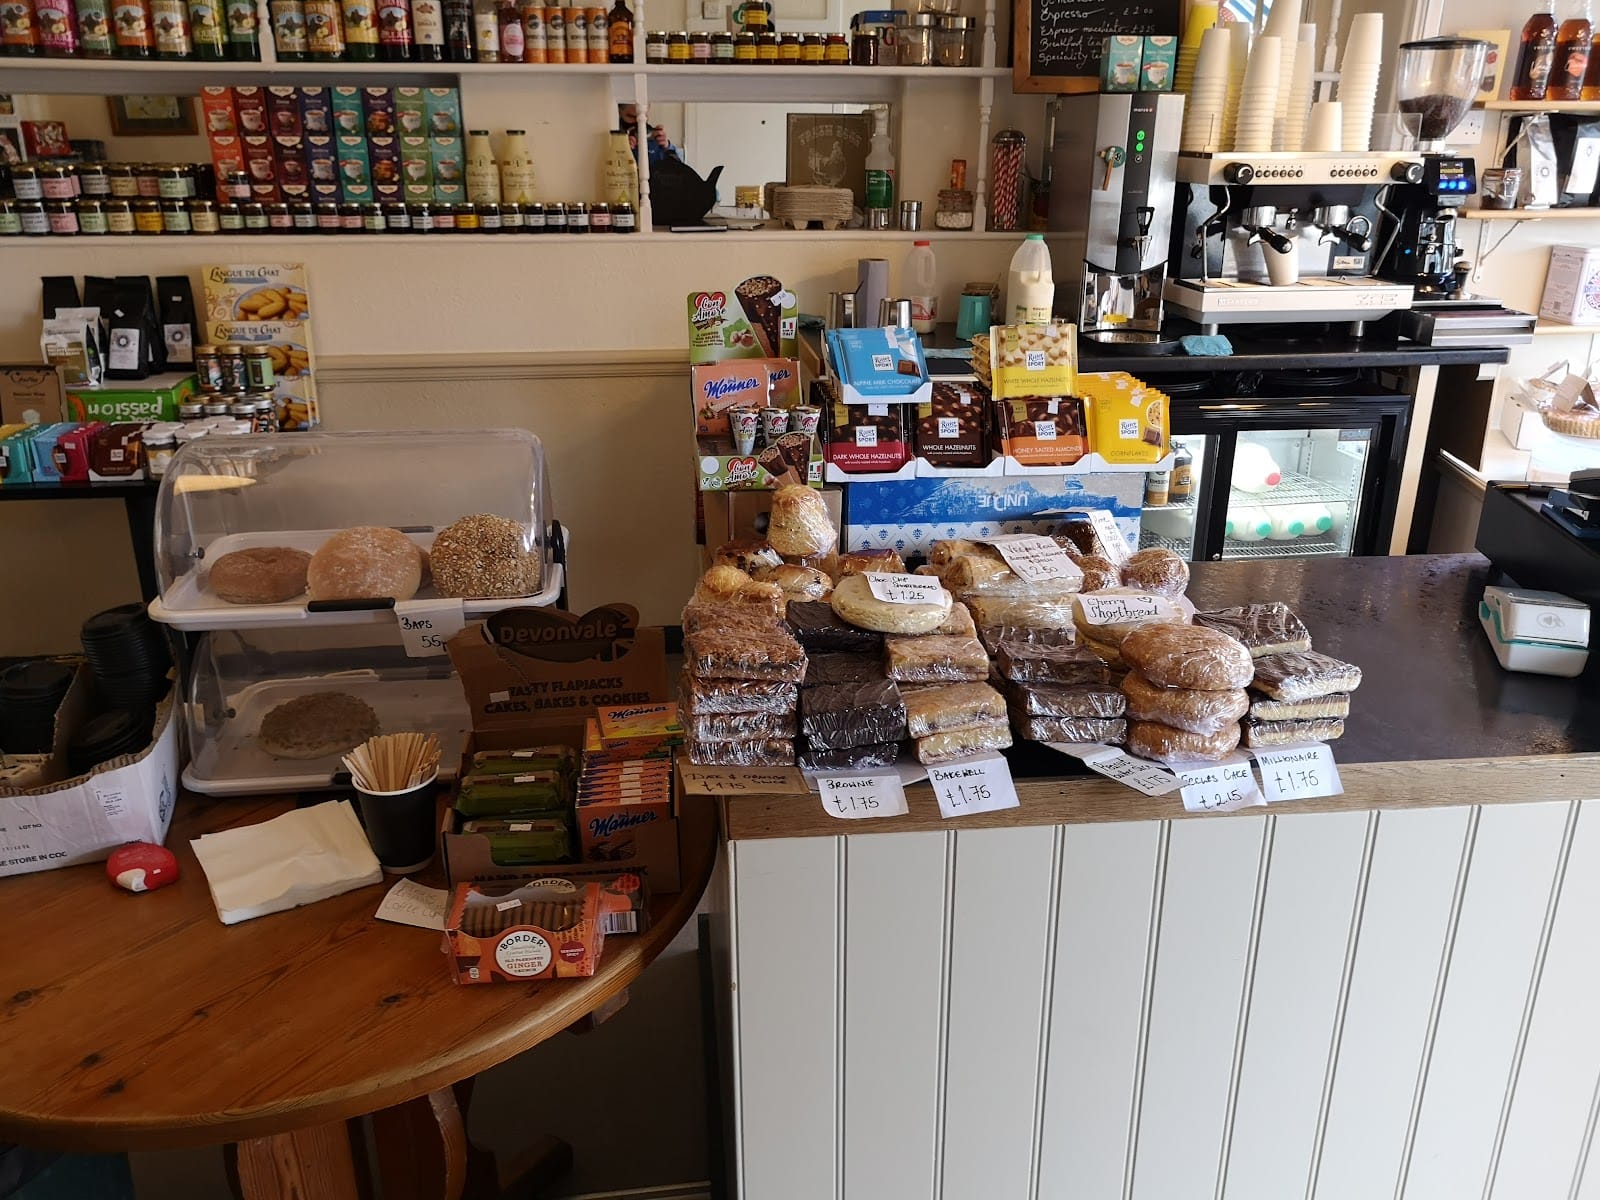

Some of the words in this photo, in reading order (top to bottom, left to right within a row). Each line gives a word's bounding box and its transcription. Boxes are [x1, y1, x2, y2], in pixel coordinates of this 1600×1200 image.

[1040, 7, 1089, 26] Espresso
[1037, 49, 1088, 69] Speciality
[210, 266, 246, 282] LANGUE
[245, 269, 255, 277] DE
[257, 266, 280, 277] CHAT
[214, 323, 246, 340] LANGUE
[248, 326, 258, 334] DE
[260, 324, 281, 335] CHAT
[703, 378, 760, 400] Manner
[87, 396, 163, 420] passion
[870, 452, 902, 460] HAZELNUTS
[977, 493, 1028, 512] UNIQUE
[886, 589, 925, 601] £1.25
[1087, 597, 1126, 610] Cherry
[1089, 604, 1160, 619] Shortbread
[401, 616, 433, 630] BAPS
[500, 617, 617, 645] Devonvale
[508, 681, 549, 698] TASTY
[552, 676, 623, 692] FLAPJACKS
[484, 700, 531, 714] CAKES,
[535, 696, 576, 710] BAKES
[578, 695, 590, 707] &
[592, 691, 651, 706] COOKIES
[607, 704, 670, 720] Manner
[1261, 751, 1320, 767] MILLIONAIRE
[933, 769, 986, 781] BAKEWELL
[1180, 773, 1220, 788] ECCLES
[1223, 768, 1250, 781] CAKE
[1273, 769, 1320, 794] £1.75
[825, 779, 875, 790] BROWNIE
[945, 784, 991, 808] £1.75
[1199, 790, 1244, 811] £2.15
[832, 795, 880, 815] £1.75
[589, 807, 659, 838] Manner
[8, 855, 38, 865] STORE
[528, 878, 572, 890] ORDER
[501, 934, 545, 951] BORDER
[506, 961, 543, 969] GINGER
